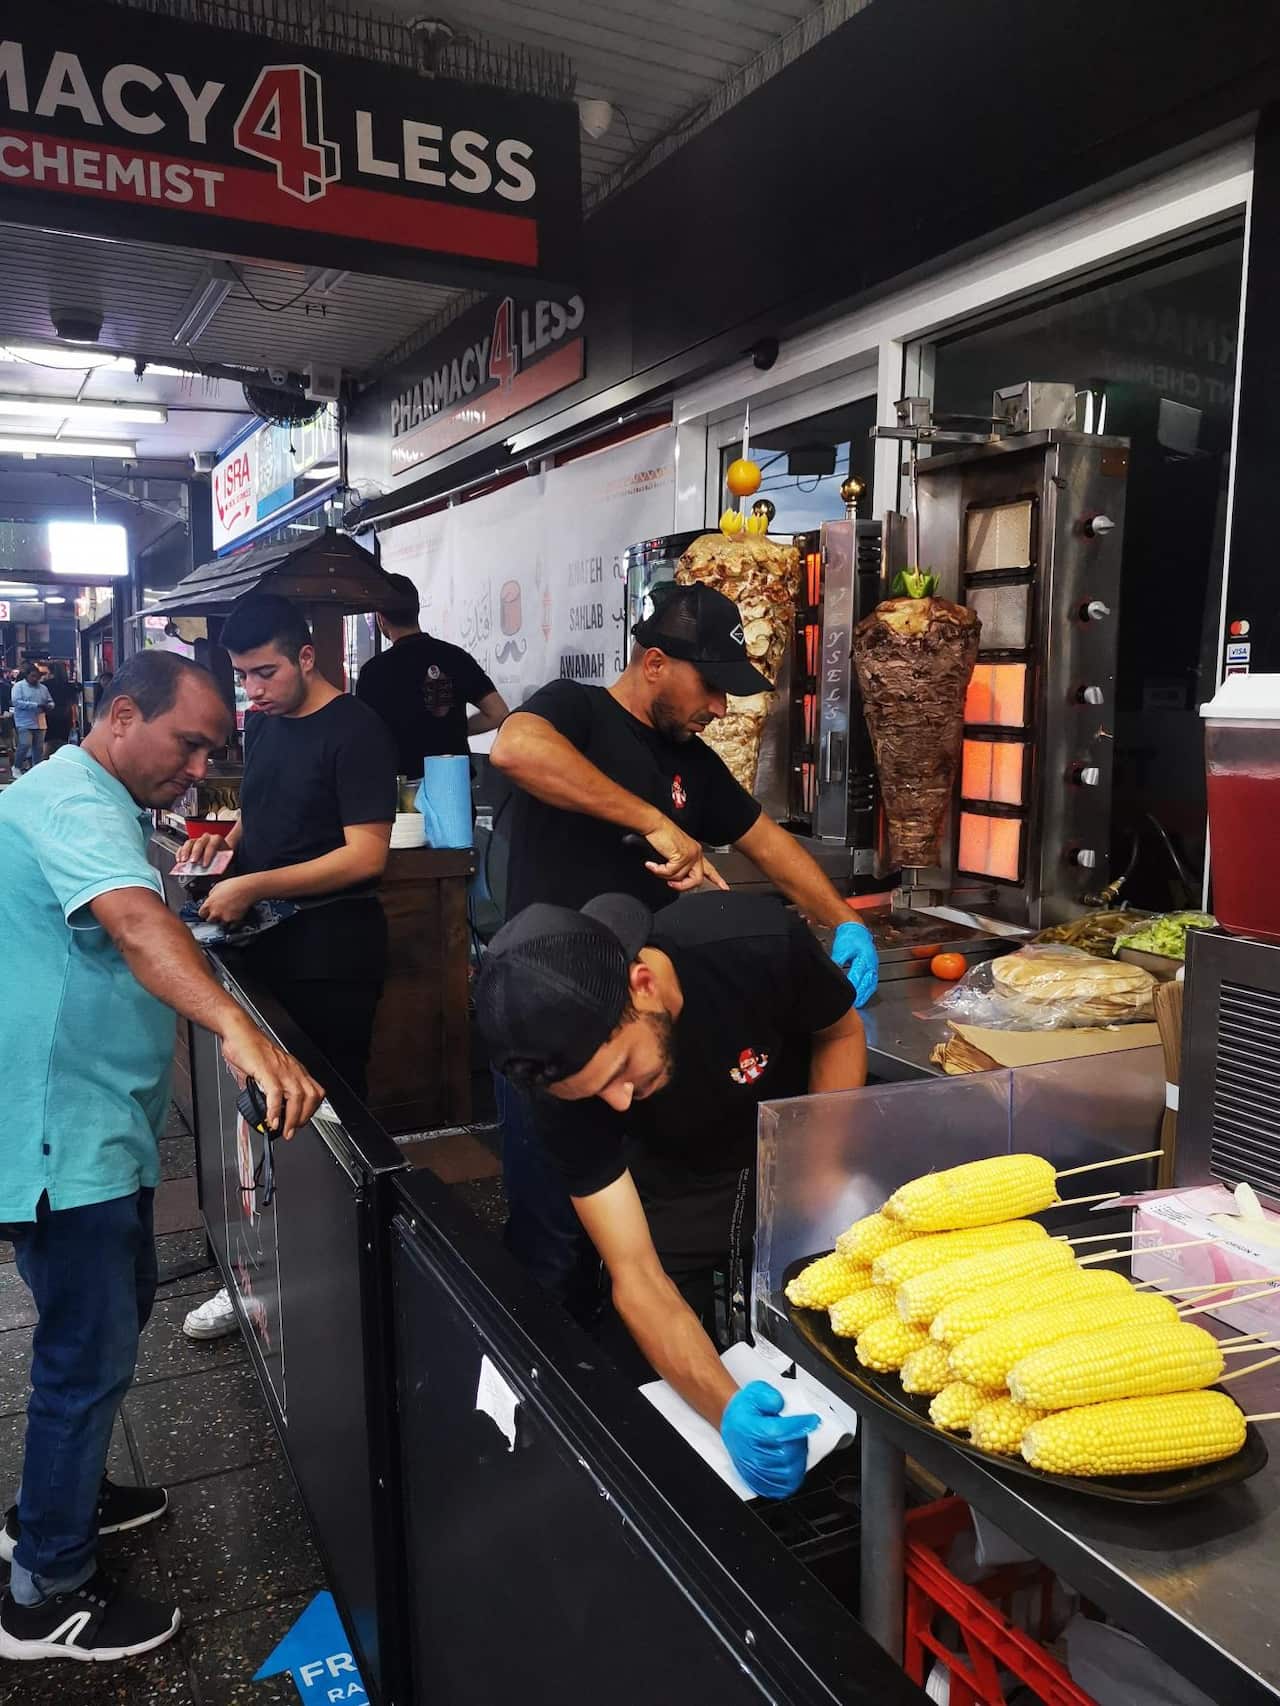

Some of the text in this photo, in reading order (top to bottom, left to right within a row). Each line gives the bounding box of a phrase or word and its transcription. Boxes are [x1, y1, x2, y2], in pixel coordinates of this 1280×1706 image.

[233, 64, 341, 203] 4
[355, 110, 537, 202] LESS
[0, 137, 224, 207] CHEMIST
[391, 295, 584, 437] PHARMACY 4 LESS
[224, 452, 250, 499] ISRA
[569, 603, 603, 631] SAHLAB
[559, 653, 605, 680] AWAMAH
[1231, 647, 1247, 656] VISA
